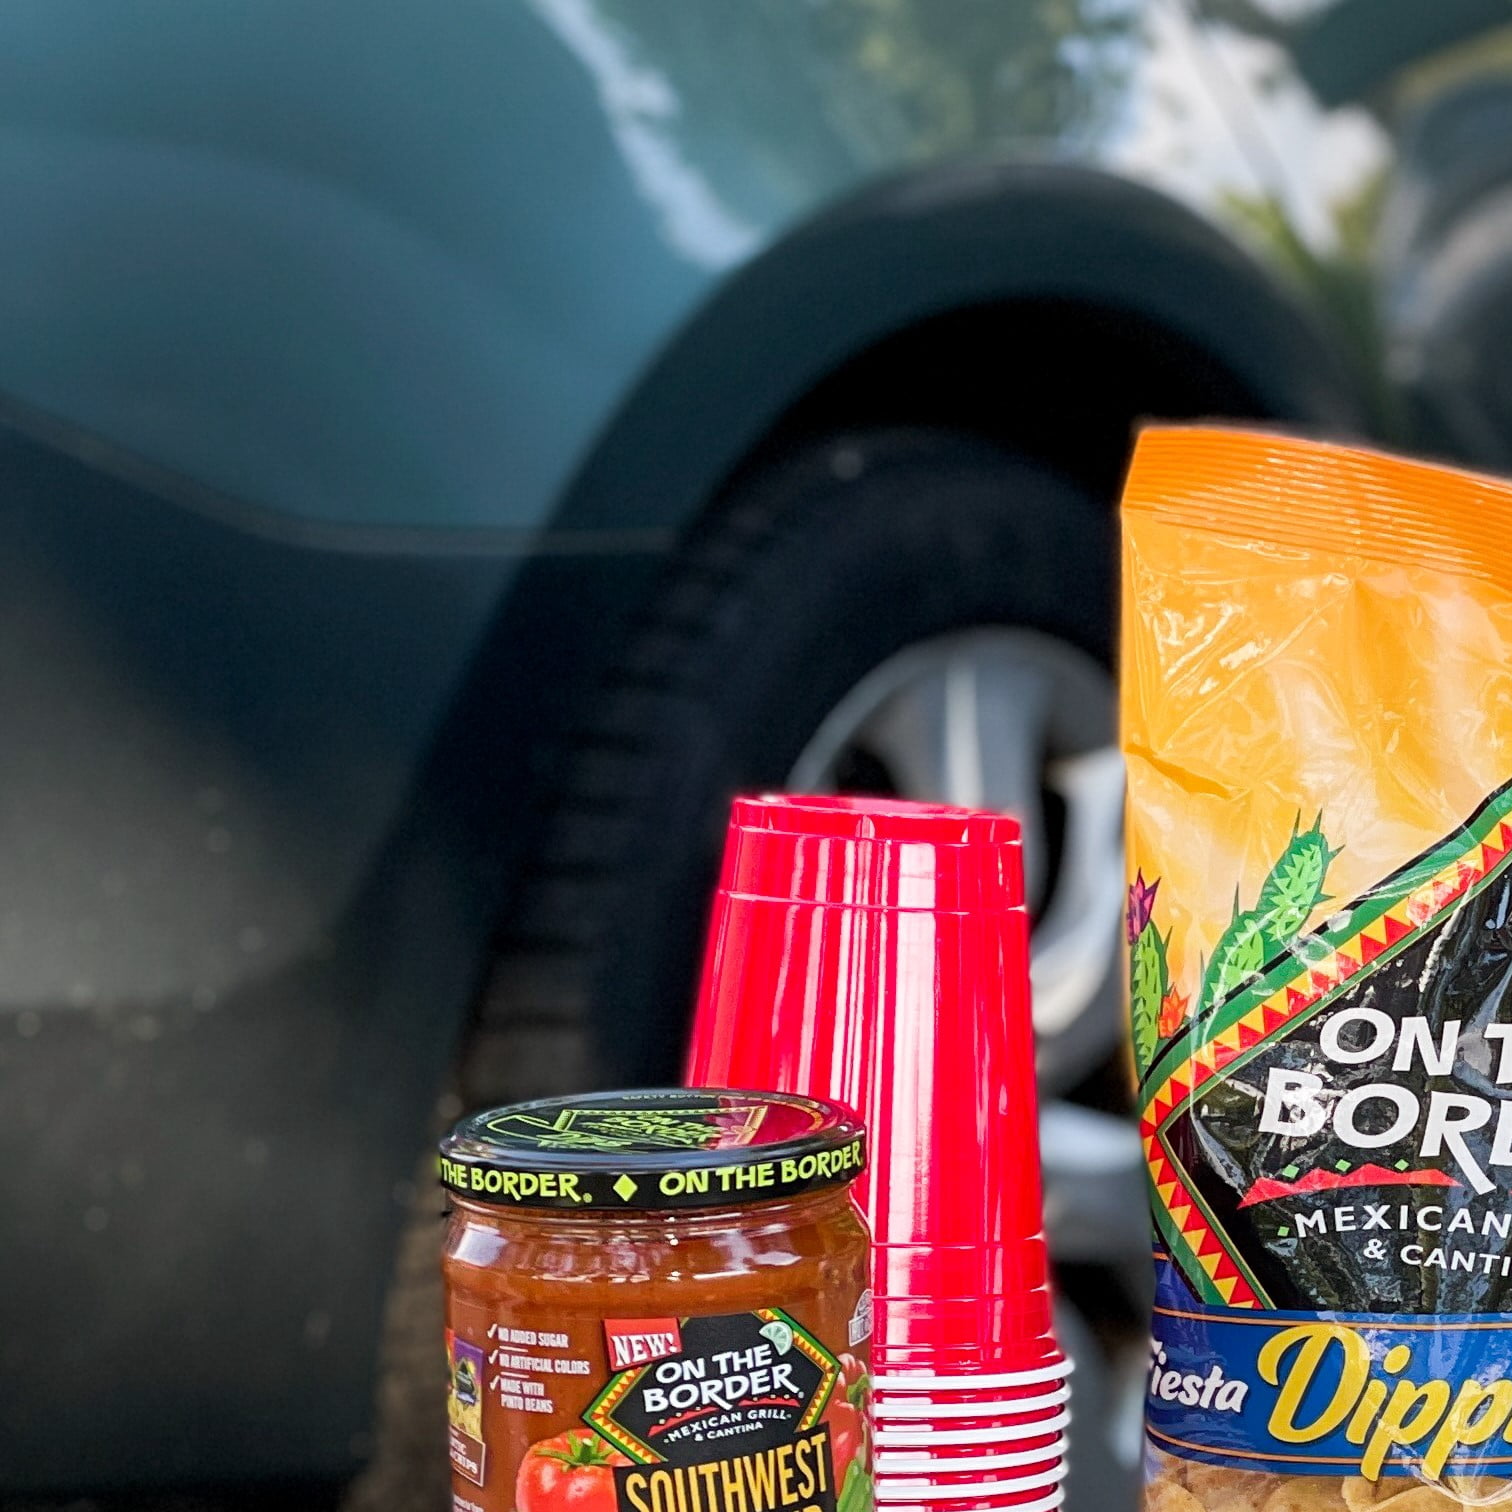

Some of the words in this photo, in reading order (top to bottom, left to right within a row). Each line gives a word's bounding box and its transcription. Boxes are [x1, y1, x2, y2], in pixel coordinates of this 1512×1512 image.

[1320, 1006, 1462, 1077] ON
[442, 1157, 467, 1188] THE
[472, 1168, 582, 1202] BORDER
[659, 1172, 713, 1196] ON
[715, 1163, 774, 1191] THE
[781, 1140, 861, 1183] BORDER
[1295, 1204, 1511, 1239] MEXICAN
[1363, 1238, 1387, 1260] &
[538, 1333, 568, 1348] SUGAR
[611, 1333, 677, 1367] NEW!
[555, 1359, 590, 1374] COLORS
[656, 1358, 706, 1384] ON
[712, 1344, 772, 1375] THE
[525, 1398, 553, 1413] BEANS
[643, 1364, 799, 1413] BORDER
[667, 1412, 741, 1442] MEXICAN
[747, 1409, 786, 1420] GRILL
[694, 1432, 704, 1441] &
[707, 1422, 763, 1440] CANTINA
